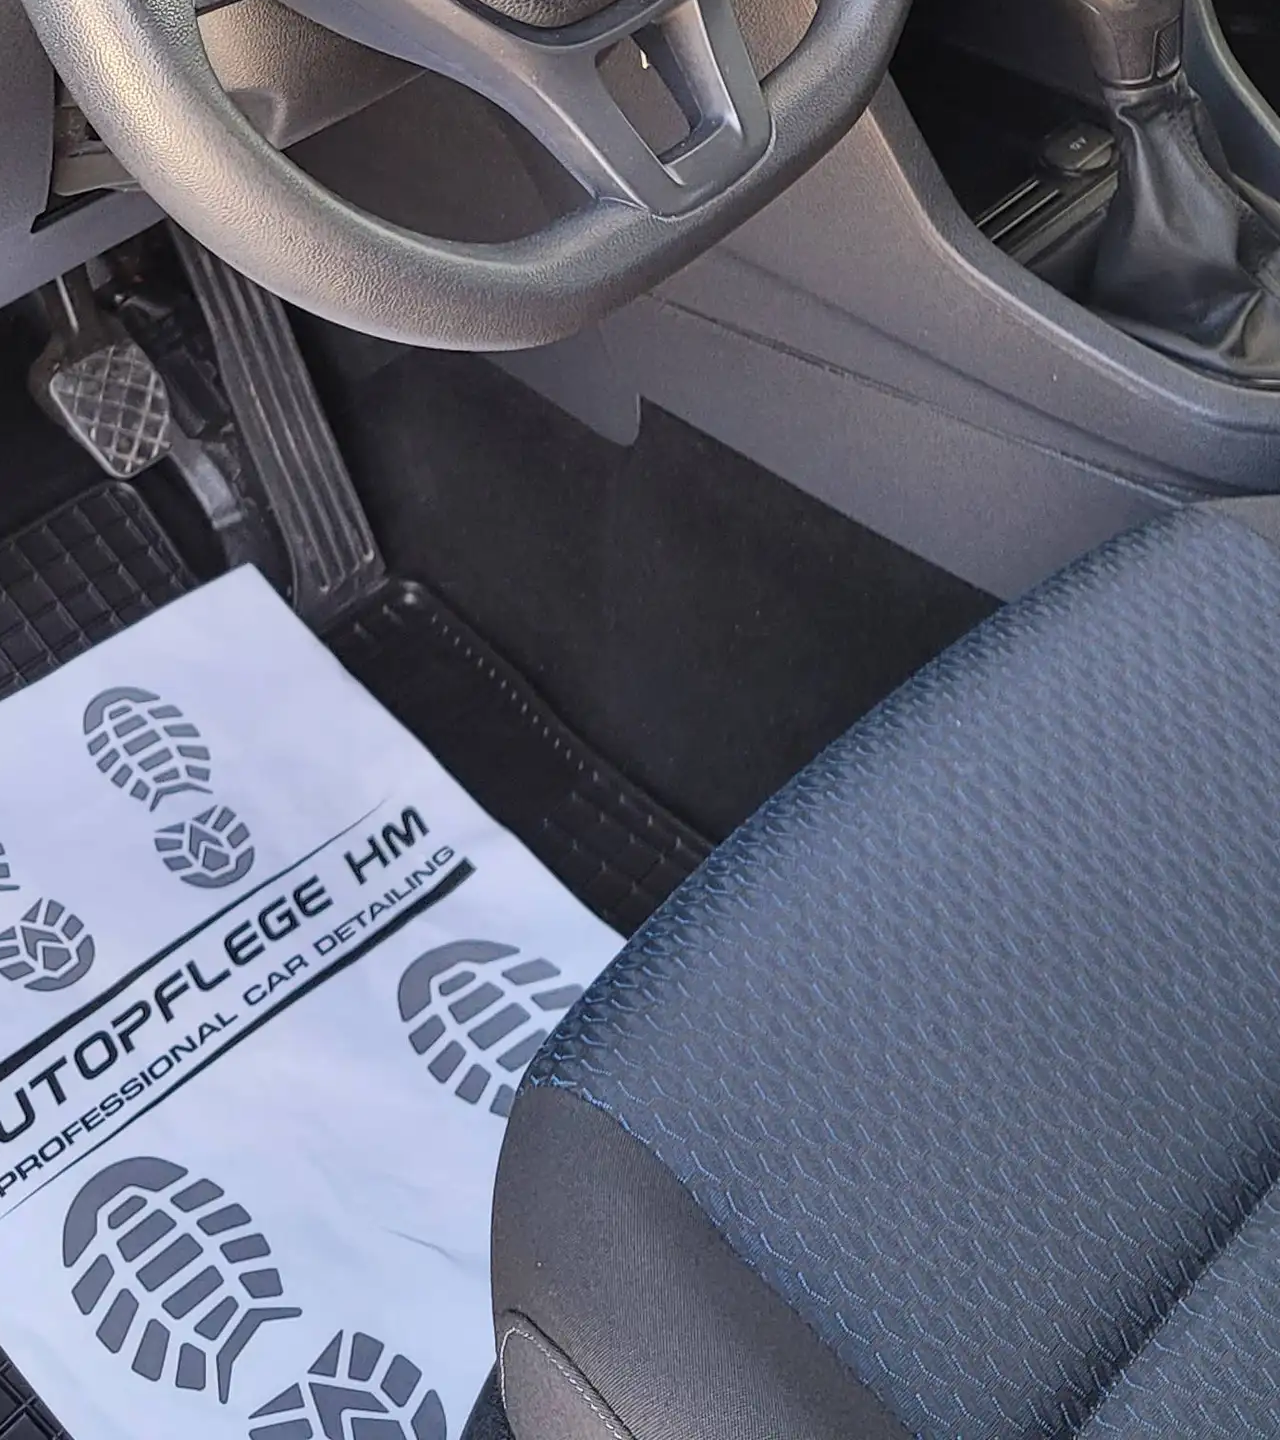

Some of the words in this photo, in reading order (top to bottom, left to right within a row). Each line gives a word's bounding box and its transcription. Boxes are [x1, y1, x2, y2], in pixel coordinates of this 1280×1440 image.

[343, 805, 430, 886] HM
[242, 954, 309, 1007] CAR
[312, 843, 457, 956] DETAILING
